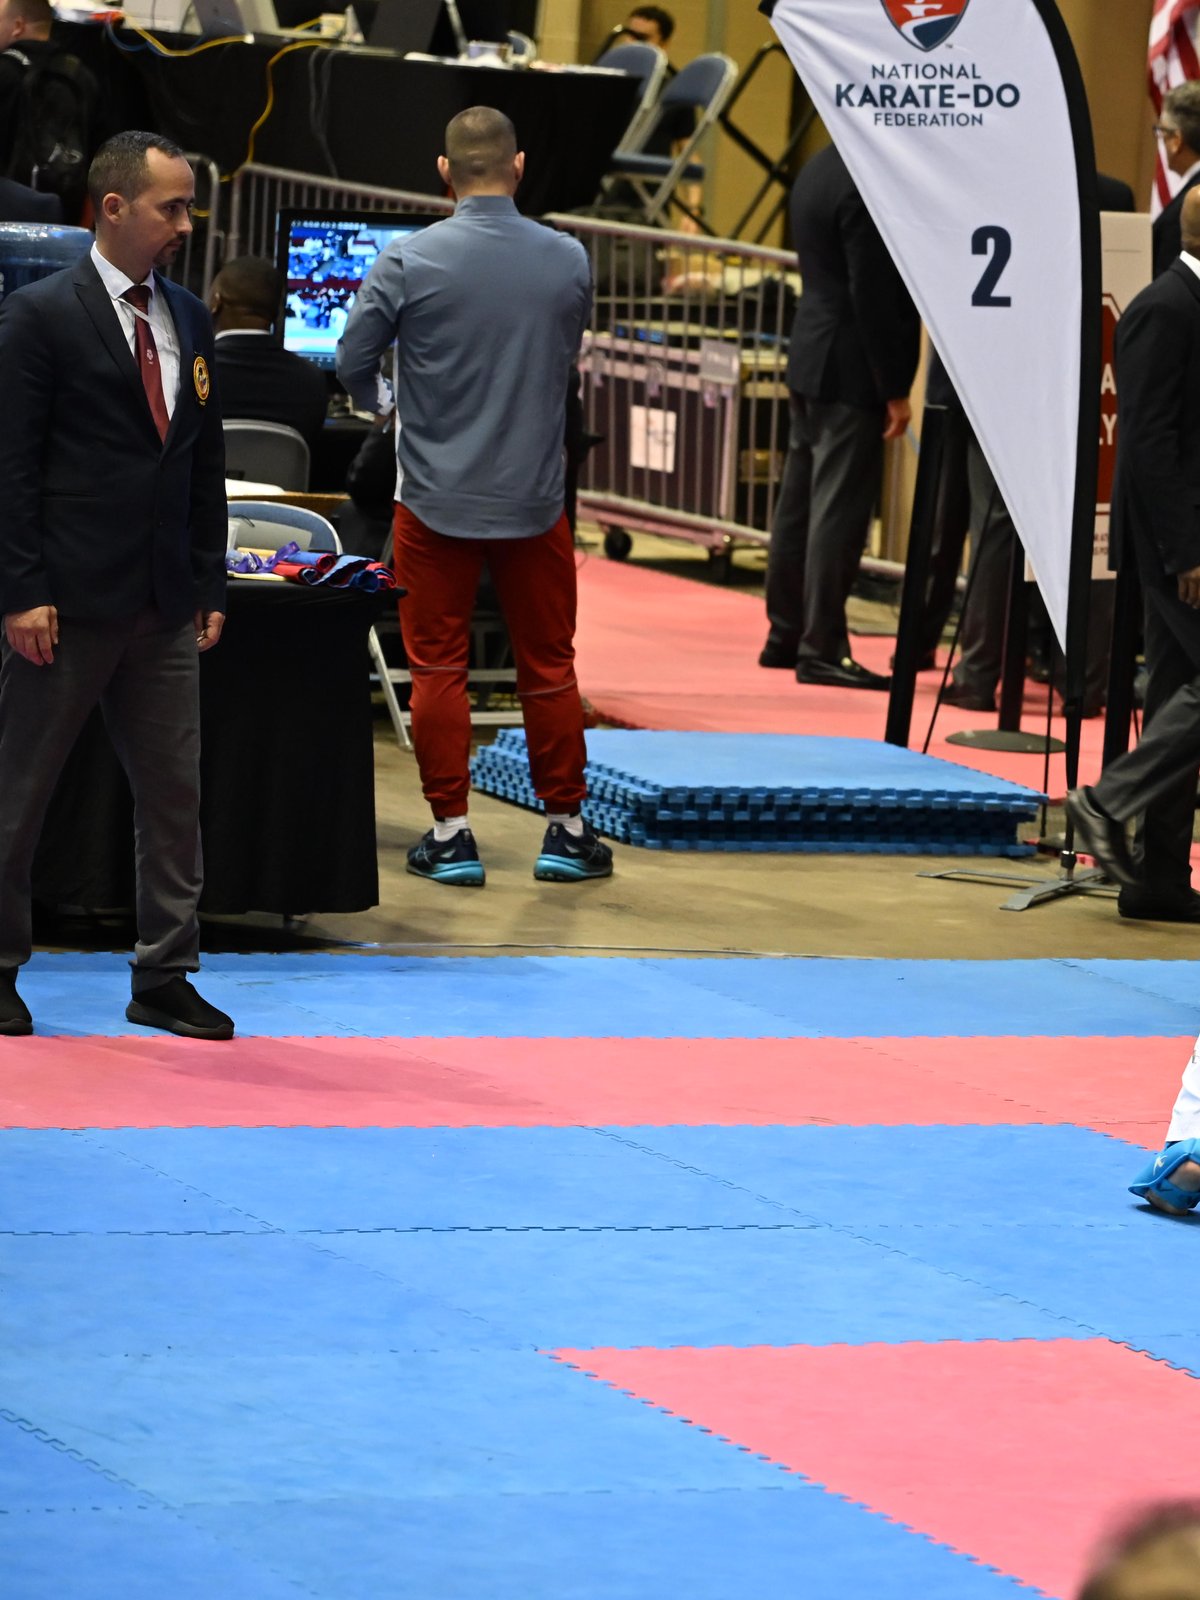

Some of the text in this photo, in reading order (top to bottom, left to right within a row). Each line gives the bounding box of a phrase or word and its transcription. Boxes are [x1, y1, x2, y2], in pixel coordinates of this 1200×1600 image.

[872, 63, 981, 80] NATIONAL
[835, 83, 1021, 109] KARATE-DO
[874, 112, 983, 127] FEDERATION
[971, 225, 1012, 308] 2
[1099, 413, 1118, 446] Y
